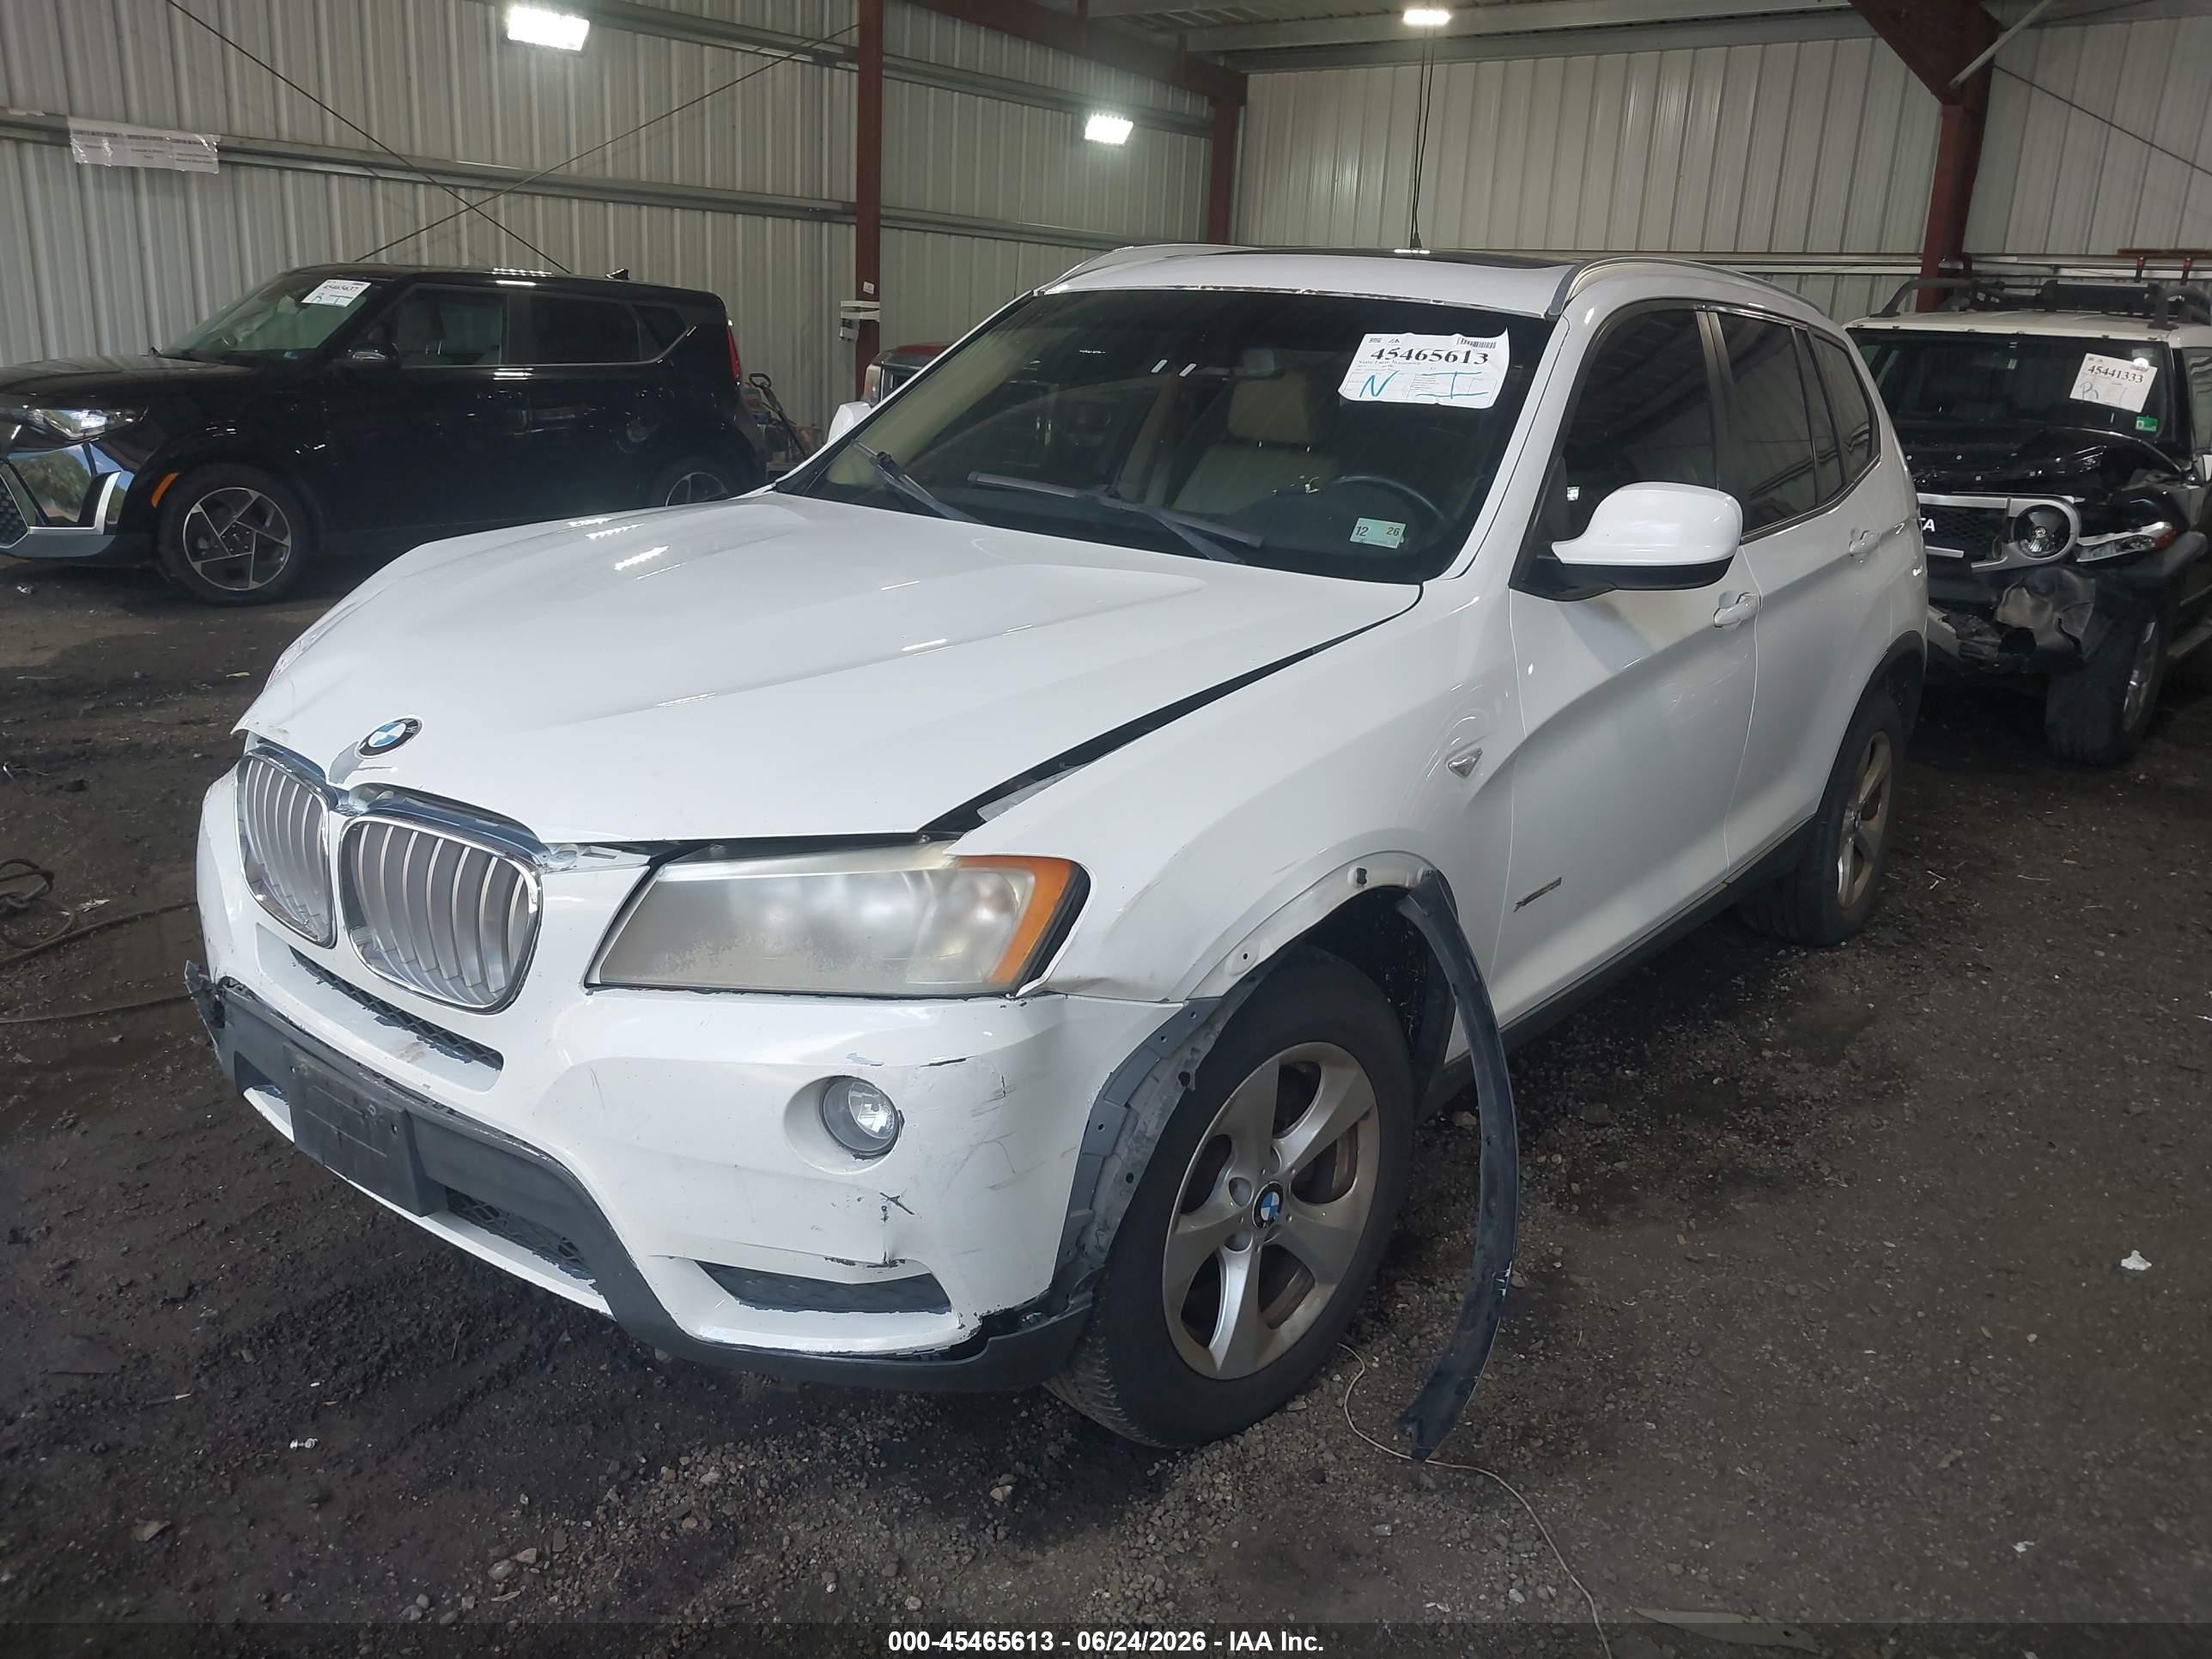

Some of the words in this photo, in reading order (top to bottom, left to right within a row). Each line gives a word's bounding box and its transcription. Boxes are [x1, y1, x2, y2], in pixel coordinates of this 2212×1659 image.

[1370, 348, 1488, 365] 45465613
[2087, 365, 2143, 383] 45441333
[1359, 370, 1400, 398] N
[1356, 526, 1369, 537] 12
[1386, 526, 1401, 537] 26
